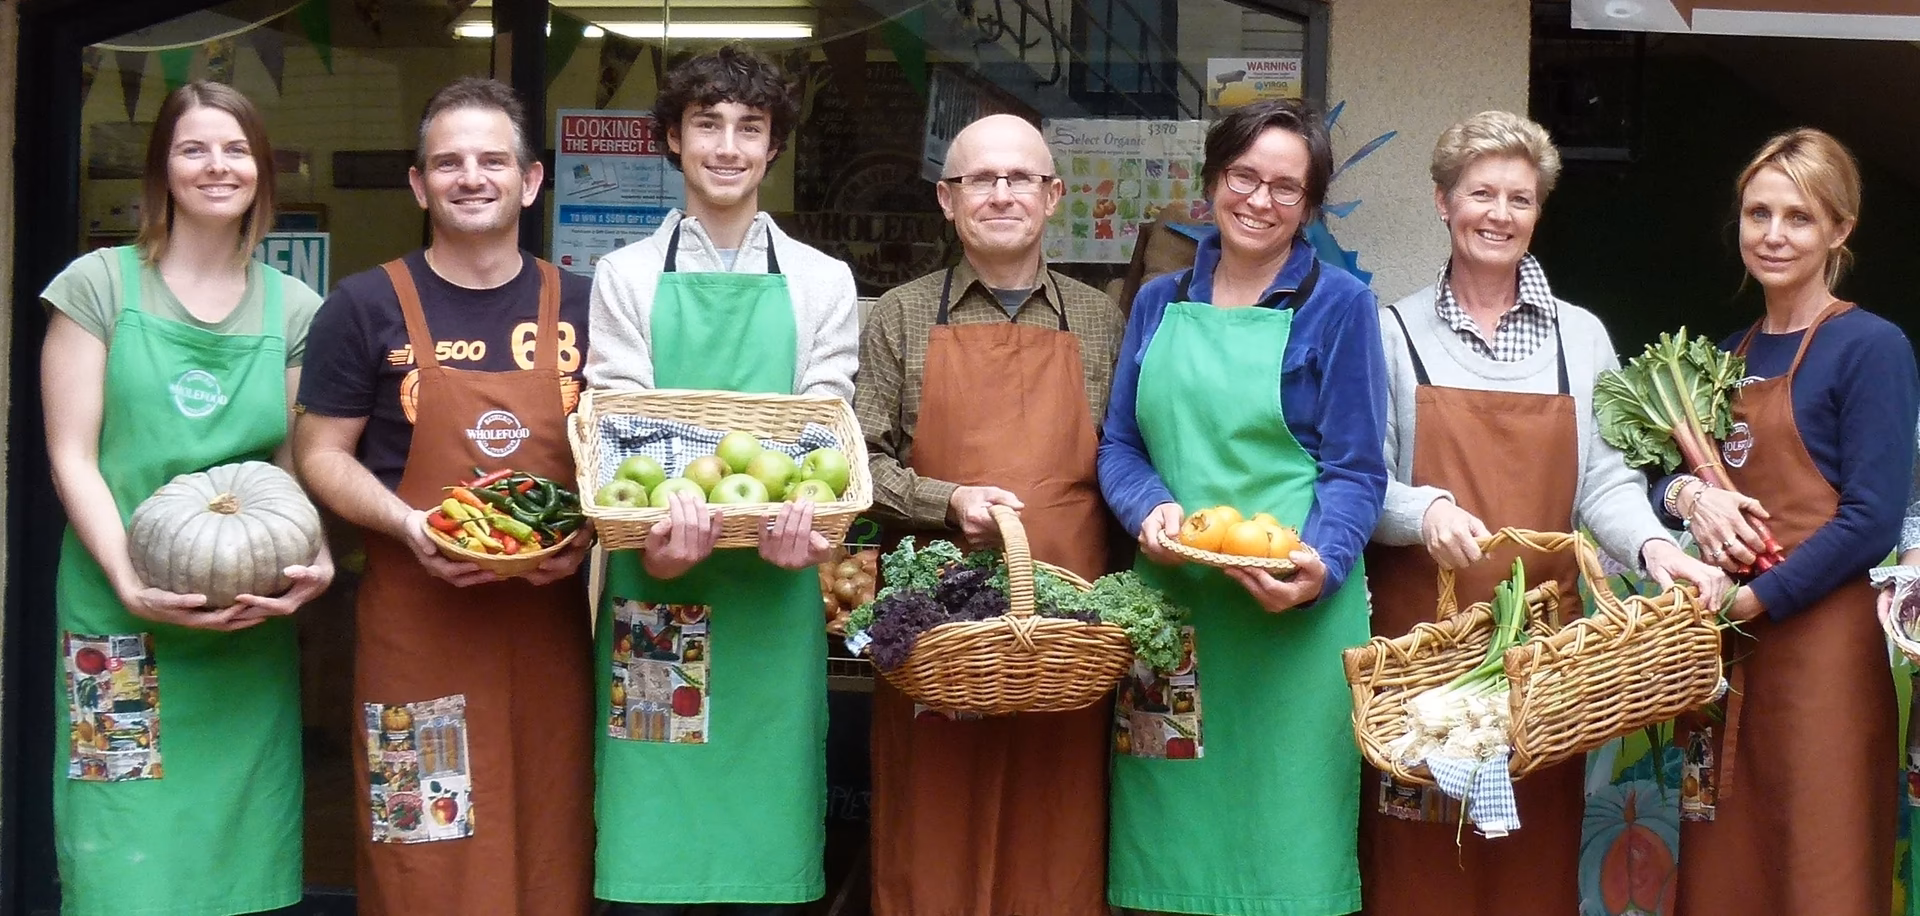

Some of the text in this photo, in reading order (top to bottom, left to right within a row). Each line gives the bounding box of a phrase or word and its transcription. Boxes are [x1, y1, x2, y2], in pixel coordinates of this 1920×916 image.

[1247, 61, 1297, 71] WARNING
[565, 118, 641, 138] LOOKING
[1048, 126, 1099, 146] Select
[1104, 132, 1146, 148] Organic
[565, 139, 588, 151] THE
[592, 139, 644, 152] PERFECT
[570, 213, 579, 222] TO
[581, 213, 597, 222] WIN
[599, 214, 604, 222] A
[627, 214, 644, 224] GIFT
[252, 239, 320, 294] EN
[465, 428, 530, 440] WHOLEFOOD
